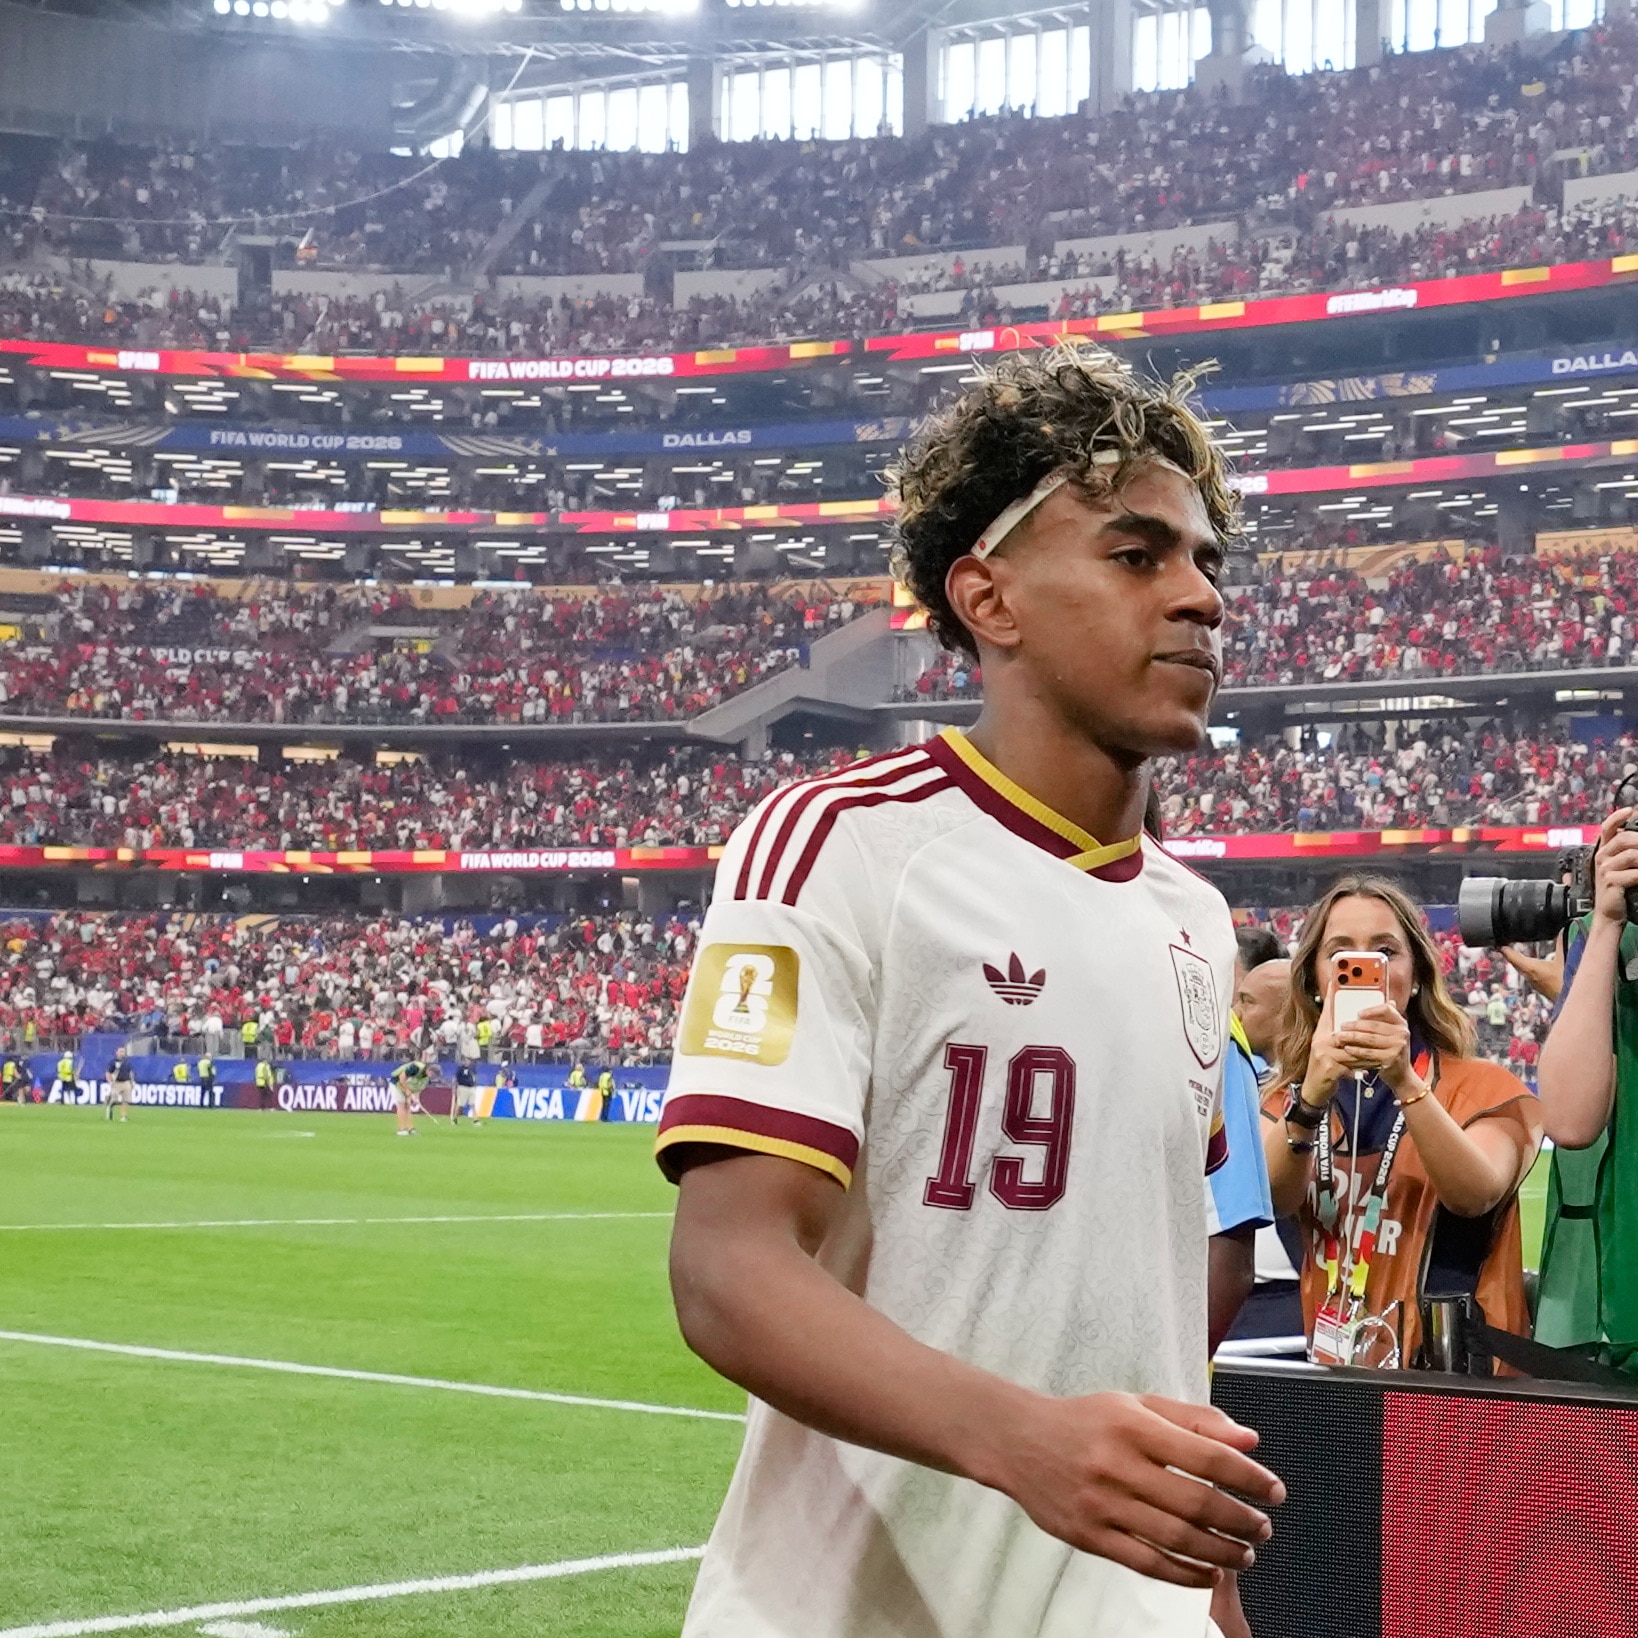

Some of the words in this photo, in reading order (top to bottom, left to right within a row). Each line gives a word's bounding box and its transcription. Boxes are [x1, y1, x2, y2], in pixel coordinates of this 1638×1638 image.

[468, 361, 510, 379] FIFA
[511, 360, 573, 379] WORLD
[575, 358, 610, 377] CUP
[611, 357, 674, 376] 2026
[210, 430, 248, 446] FIFA
[249, 432, 310, 449] WORLD
[312, 434, 344, 449] CUP
[346, 434, 402, 450] 2026
[663, 430, 752, 448] DALLAS
[461, 853, 489, 869] FIFA
[490, 852, 539, 869] WORLD
[540, 851, 568, 868] CUP
[569, 851, 616, 868] 2026
[728, 1015, 751, 1026] FIFA
[703, 1037, 761, 1055] 2026
[277, 1084, 337, 1113] QATAR
[511, 1087, 564, 1119] VISA
[617, 1088, 666, 1122] VIS
[921, 1042, 1077, 1212] 19
[1386, 1136, 1400, 1153] CUP
[1320, 1157, 1331, 1181] FIFA
[1375, 1152, 1395, 1187] 2026
